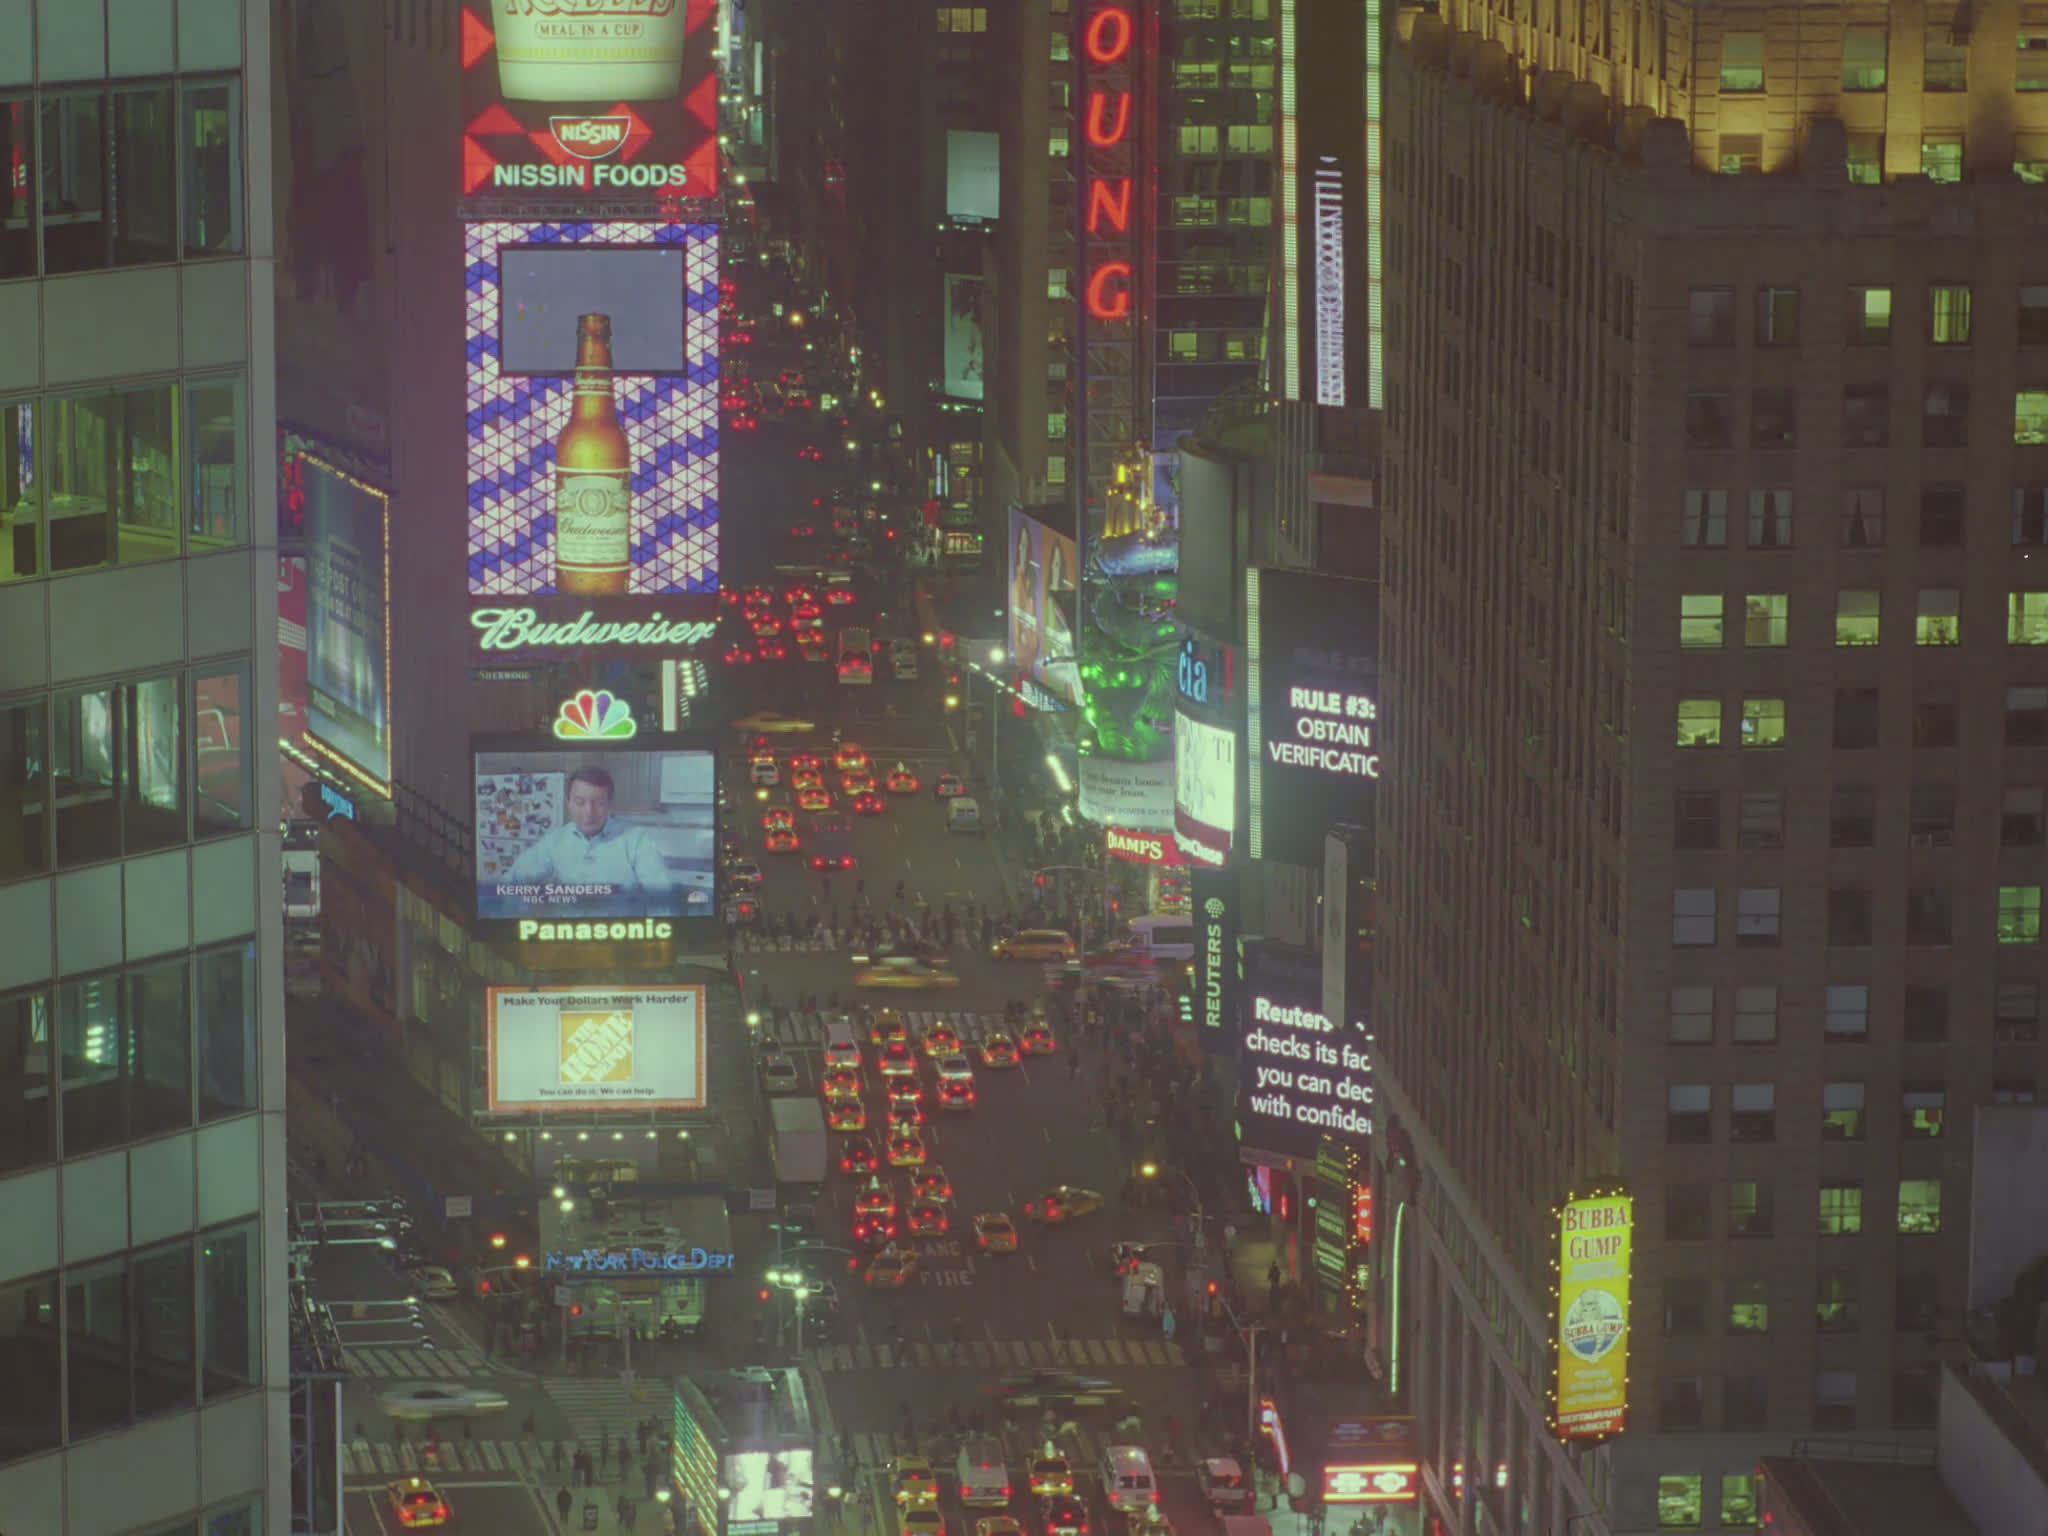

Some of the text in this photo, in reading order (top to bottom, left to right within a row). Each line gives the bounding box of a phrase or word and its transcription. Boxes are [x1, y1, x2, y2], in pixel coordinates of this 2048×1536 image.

[540, 23, 640, 36] MEAL IN A CUP
[560, 121, 621, 144] NISSIN
[494, 164, 687, 187] NISSIN FOODS
[470, 608, 716, 650] Budweiser
[1290, 687, 1377, 719] RULE #3:
[1297, 716, 1370, 748] OBTAIN
[496, 883, 612, 896] KERRY SANDERS
[523, 895, 577, 904] NBC NEWS
[519, 918, 672, 940] Panasonic
[1206, 924, 1222, 1028] REUTERS
[503, 994, 688, 1006] Make Your Dollars Work Harder
[1246, 1027, 1310, 1060] checks
[1315, 1041, 1338, 1065] its
[1257, 1066, 1373, 1103] you can dec
[1251, 1093, 1291, 1119] with
[1565, 1205, 1627, 1232] BUBBA
[1569, 1235, 1622, 1260] GUMP
